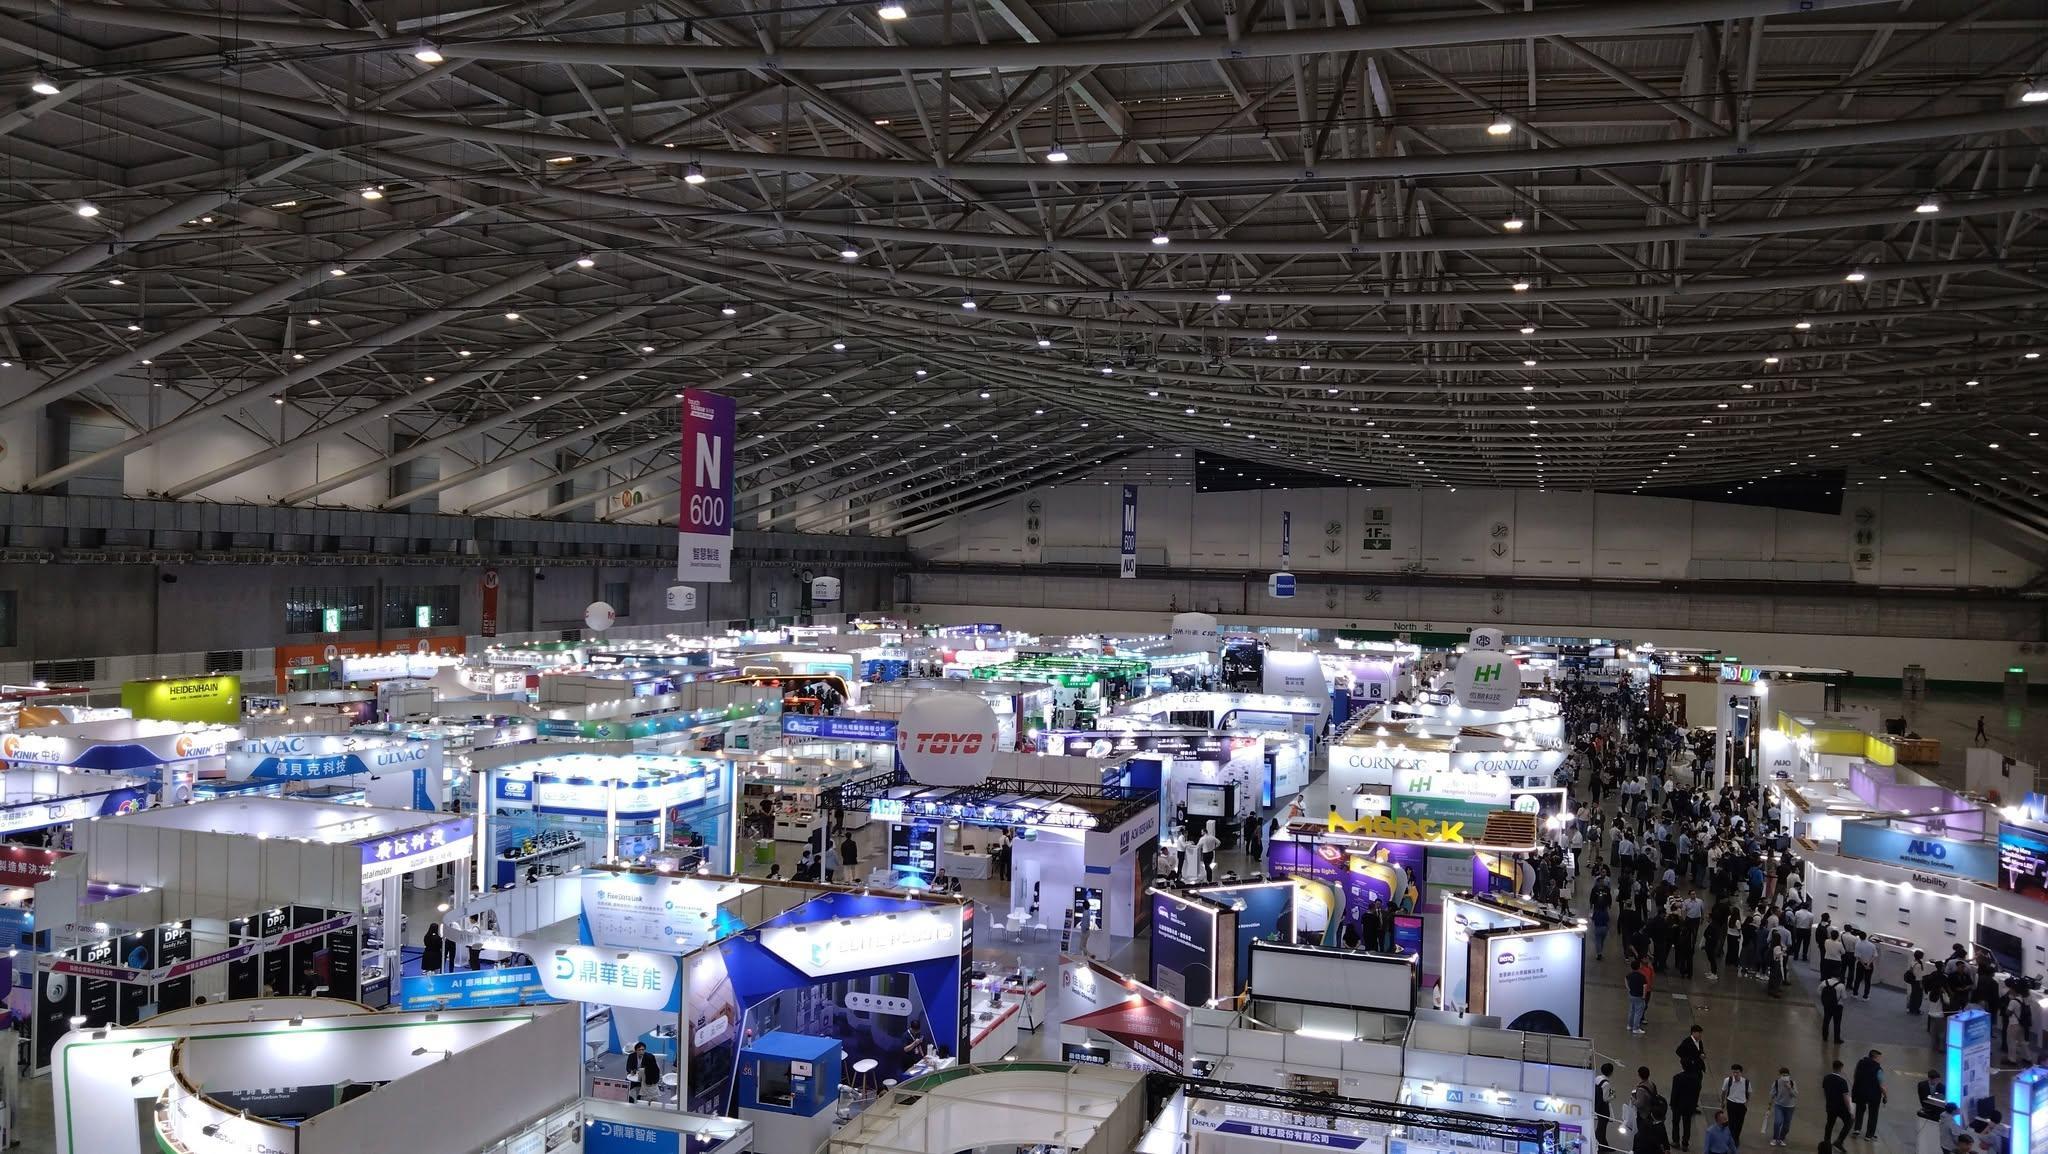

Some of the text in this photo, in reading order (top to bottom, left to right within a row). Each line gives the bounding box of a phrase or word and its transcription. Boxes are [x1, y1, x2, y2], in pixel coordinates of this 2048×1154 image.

[695, 432, 722, 490] N
[690, 495, 724, 526] 600
[1125, 505, 1134, 532] M
[1366, 528, 1382, 538] 1F
[1394, 622, 1417, 632] North
[169, 682, 219, 695] HEIDENHAIN
[917, 733, 983, 754] TOYO
[13, 750, 38, 760] KINIK
[377, 748, 425, 767] ULVAC
[276, 760, 347, 776] 優貝克科技
[1474, 759, 1539, 772] CORNING
[1328, 809, 1464, 843] MERCK
[1908, 839, 1947, 860] AUO
[1913, 874, 1947, 888] Mobility
[267, 915, 285, 928] DPP
[88, 947, 111, 962] DPP
[451, 979, 463, 988] AI
[579, 960, 662, 991] 鼎華智能
[613, 1125, 657, 1144] 鼎華智能
